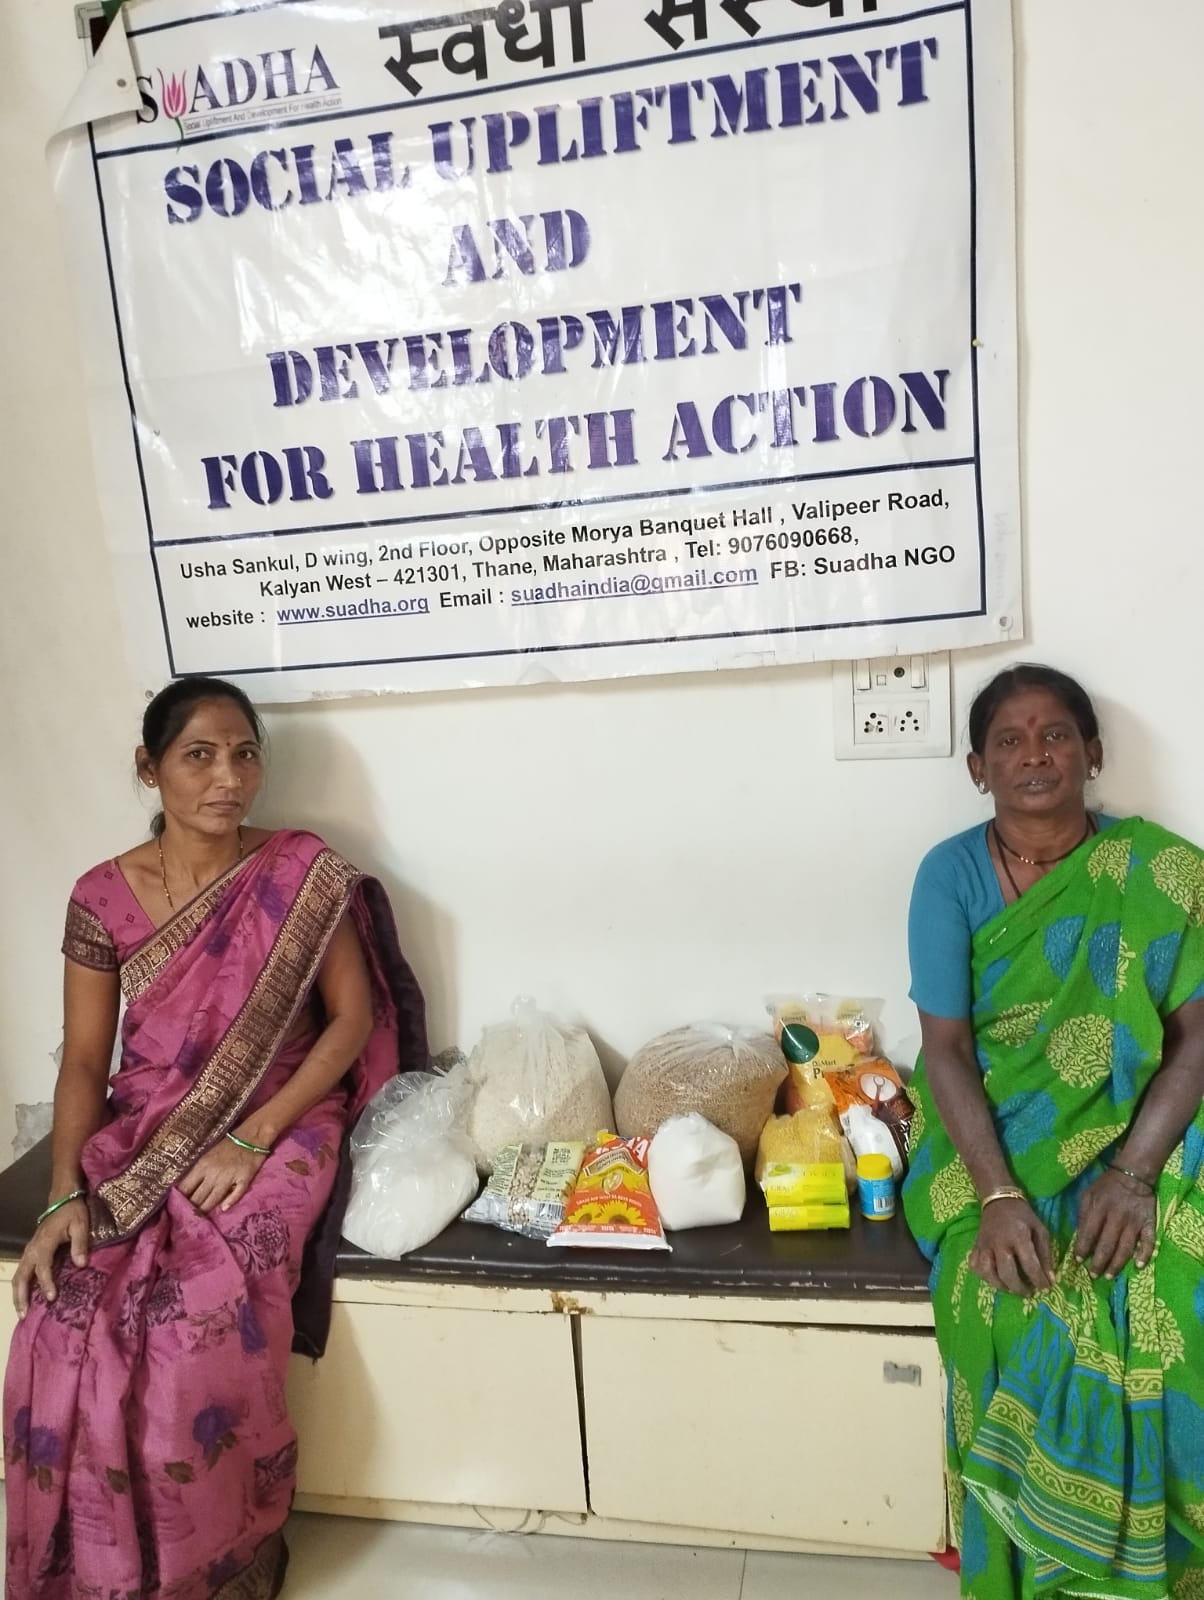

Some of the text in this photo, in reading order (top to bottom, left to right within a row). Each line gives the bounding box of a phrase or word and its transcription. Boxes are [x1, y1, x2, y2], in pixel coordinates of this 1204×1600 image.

[378, 0, 594, 97] स्वधा
[164, 37, 939, 225] SOCIAL UPLIFTMENT
[233, 110, 246, 122] And
[288, 103, 300, 114] For
[322, 97, 342, 109] Action
[442, 209, 592, 286] AND
[266, 283, 803, 407] DEVELOPMENT
[201, 369, 950, 509] FOR HEALTH ACTION
[180, 560, 227, 578] Usha
[233, 555, 299, 575] Sankul,
[305, 552, 317, 568] D
[323, 549, 373, 568] wing,
[379, 543, 412, 561] 2nd
[419, 540, 473, 557] Floor,
[479, 530, 566, 554] Opposite
[572, 523, 633, 544] Morya
[640, 512, 725, 537] Banquet
[733, 506, 772, 527] Hall
[792, 498, 881, 522] Valipeer
[888, 489, 949, 511] Road,
[260, 578, 321, 598] Kalyan
[325, 573, 372, 591] West
[393, 566, 466, 585] 421301,
[472, 560, 537, 578] Thane,
[543, 546, 667, 572] Maharashtra
[684, 540, 721, 558] Tel:
[728, 526, 859, 555] 9076090668,
[186, 608, 254, 629] website
[276, 597, 430, 623] www.suadha.org
[440, 589, 492, 608] Email
[511, 568, 758, 604] suadhaindia@gmail.com
[770, 560, 806, 579] FB:
[814, 553, 897, 575] Suadha
[904, 545, 956, 567] NGO
